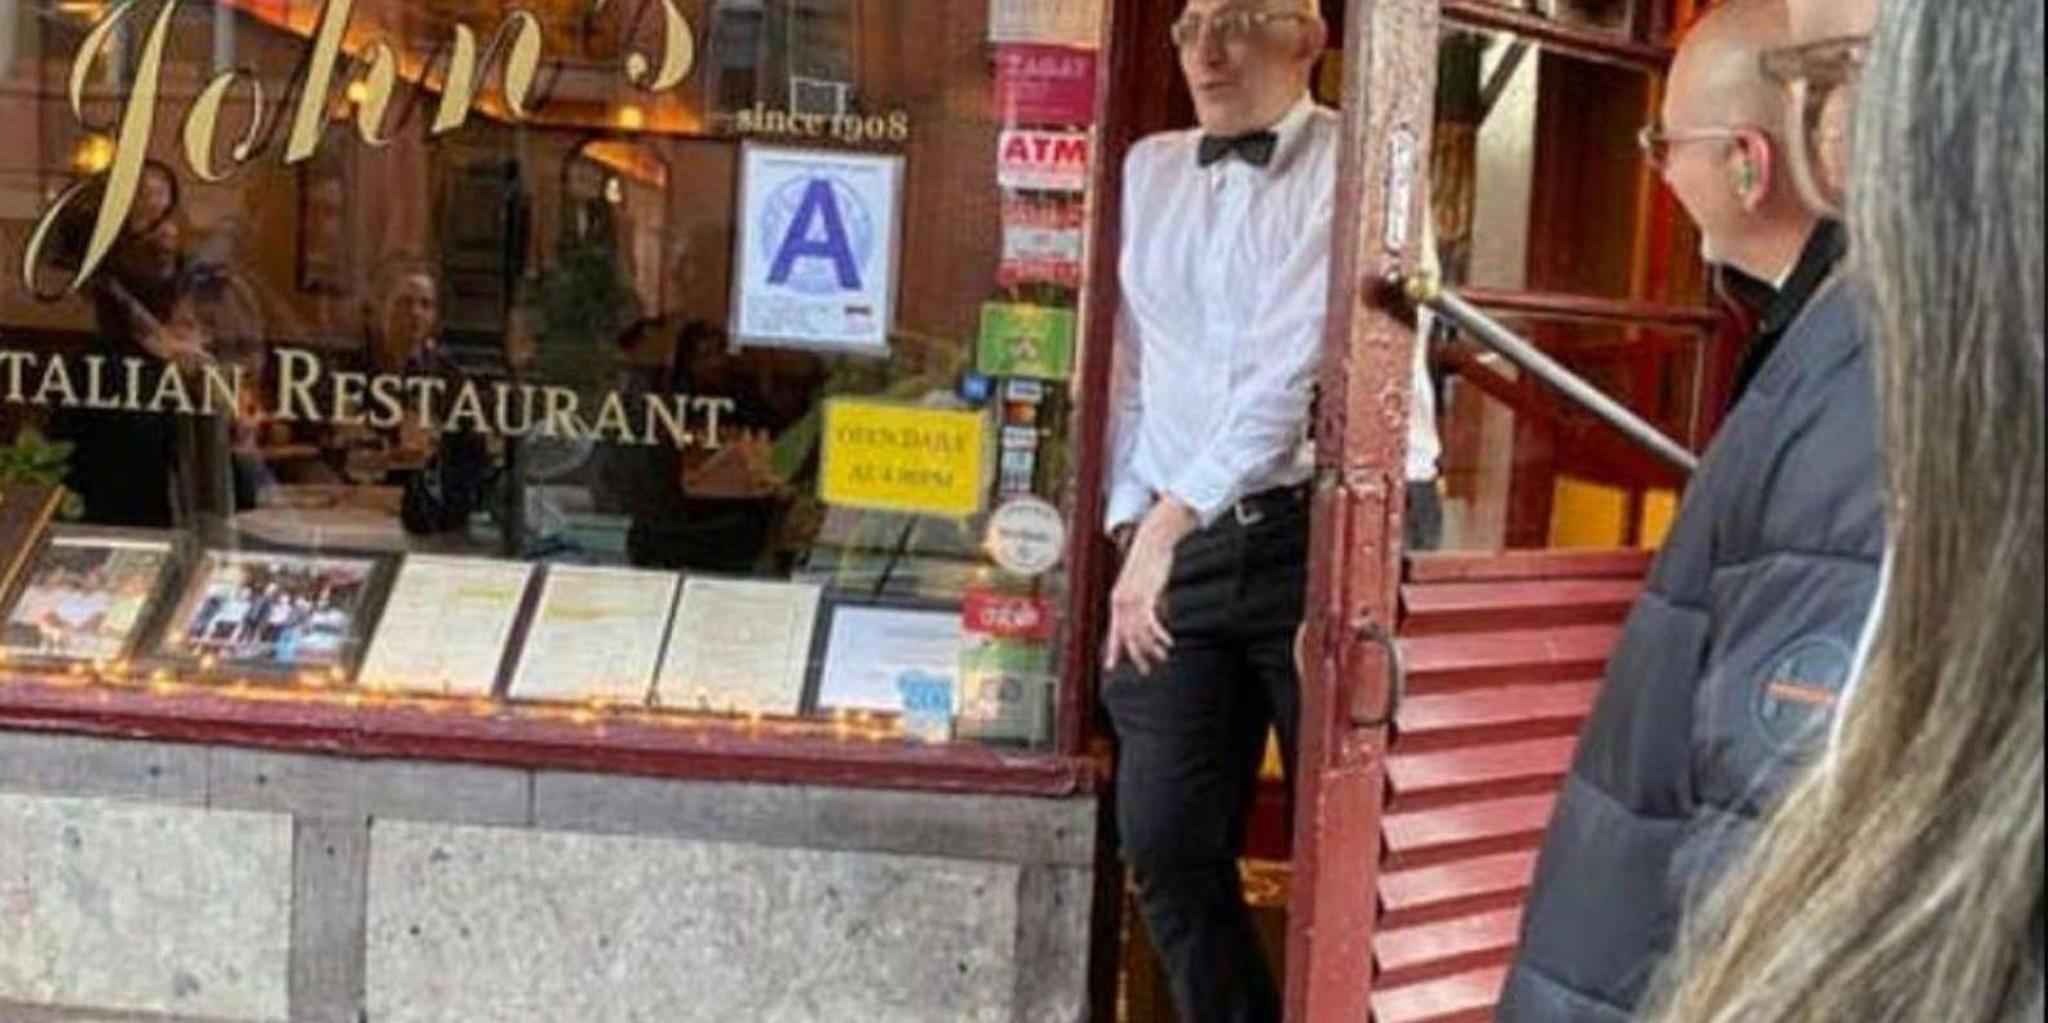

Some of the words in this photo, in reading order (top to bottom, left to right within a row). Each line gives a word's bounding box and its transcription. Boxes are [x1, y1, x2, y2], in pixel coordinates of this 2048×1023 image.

[24, 0, 694, 298] Johns
[736, 102, 826, 136] since
[832, 110, 908, 142] 1908
[1005, 136, 1087, 163] ATM
[767, 178, 863, 290] A
